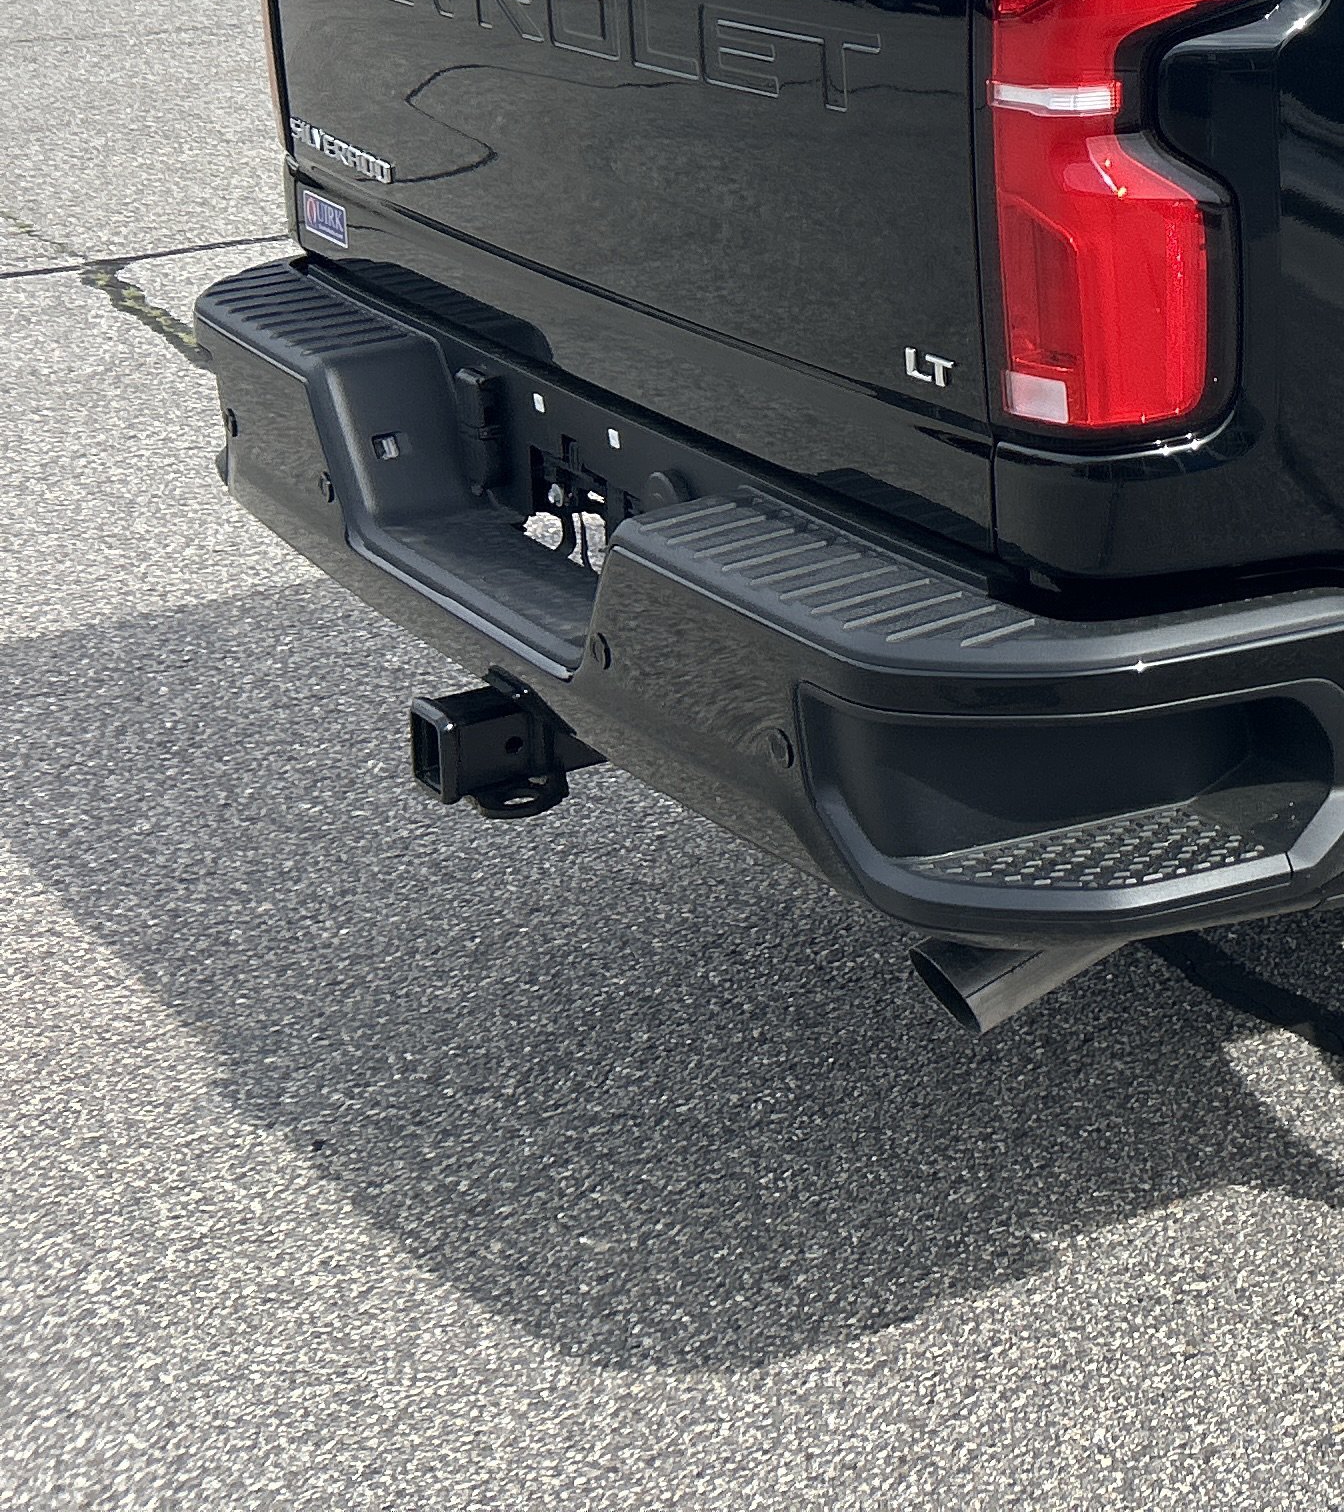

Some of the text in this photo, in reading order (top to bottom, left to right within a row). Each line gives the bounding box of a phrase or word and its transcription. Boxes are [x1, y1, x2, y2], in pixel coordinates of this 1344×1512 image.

[289, 117, 393, 184] SILVERADO
[305, 197, 344, 232] QUIRK
[904, 347, 955, 388] LT
